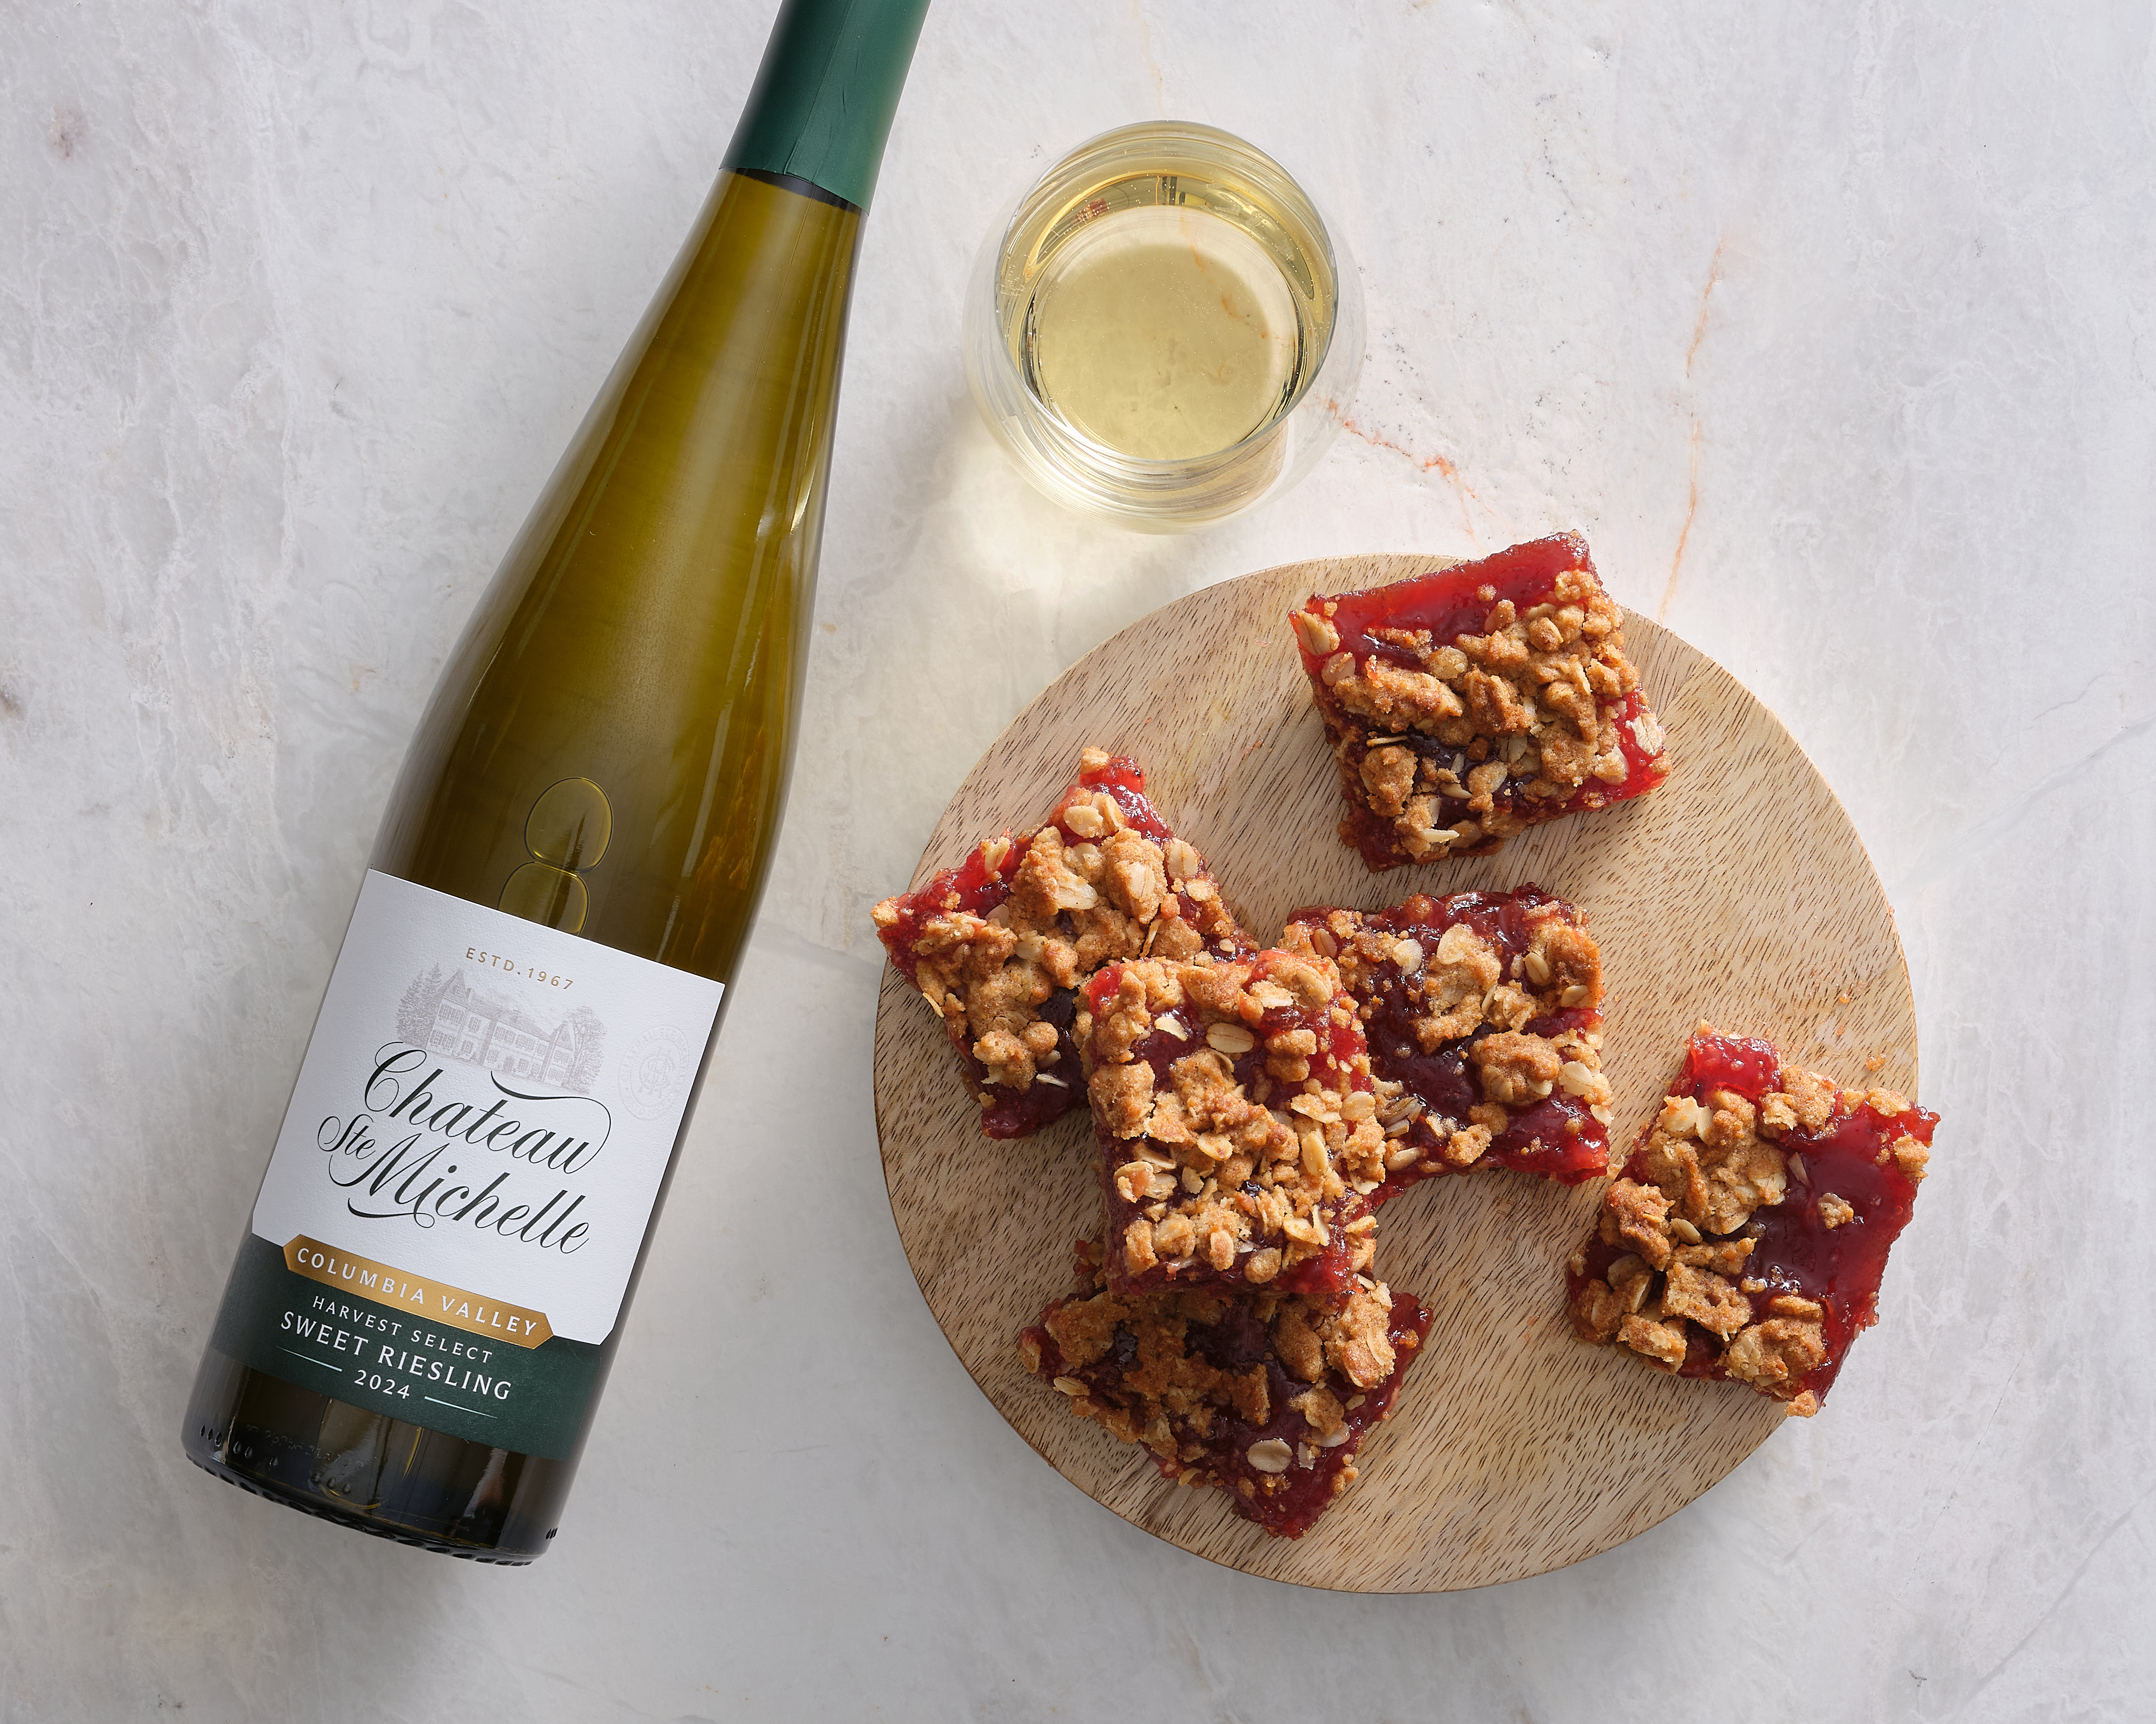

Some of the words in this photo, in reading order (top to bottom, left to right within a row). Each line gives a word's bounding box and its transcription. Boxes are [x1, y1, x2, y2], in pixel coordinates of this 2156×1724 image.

[465, 947, 574, 990] ESTD.1967
[317, 1114, 376, 1160] Ste
[365, 1042, 611, 1174] Chateau
[329, 1133, 590, 1254] Michelle
[297, 1247, 424, 1305] COLUMBIA
[442, 1295, 537, 1336] VALLEY
[312, 1296, 402, 1336] HARVEST
[410, 1330, 493, 1363] SELECT
[280, 1311, 369, 1355] SWEET
[377, 1345, 512, 1399] RIESLING
[354, 1369, 410, 1399] 2024
